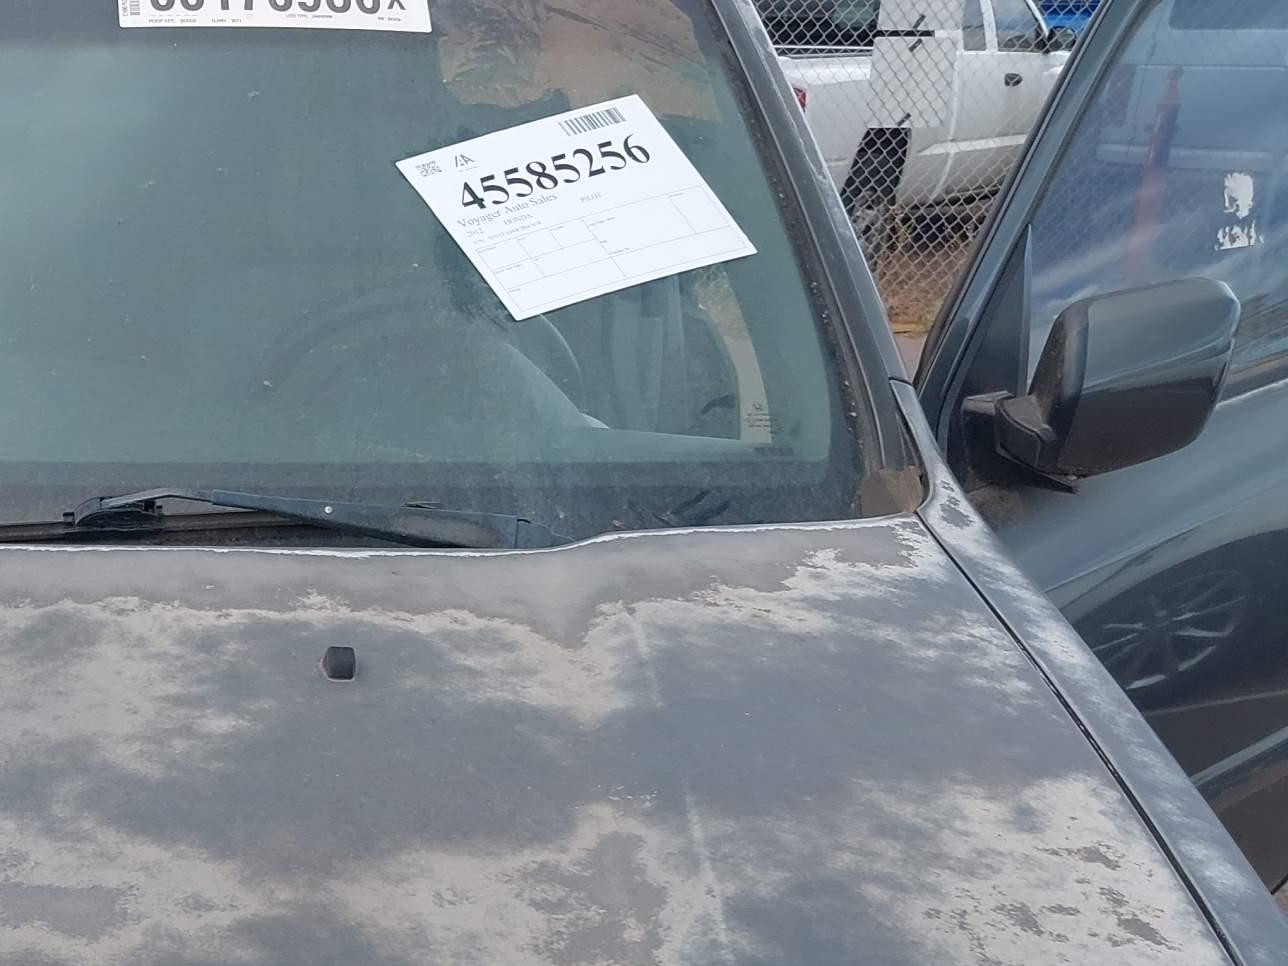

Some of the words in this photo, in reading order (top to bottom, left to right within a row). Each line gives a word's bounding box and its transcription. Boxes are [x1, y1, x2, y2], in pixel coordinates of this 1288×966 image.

[461, 133, 650, 209] 45585256
[456, 210, 502, 227] Voyager
[504, 202, 529, 214] Auto
[528, 193, 558, 207] Sales
